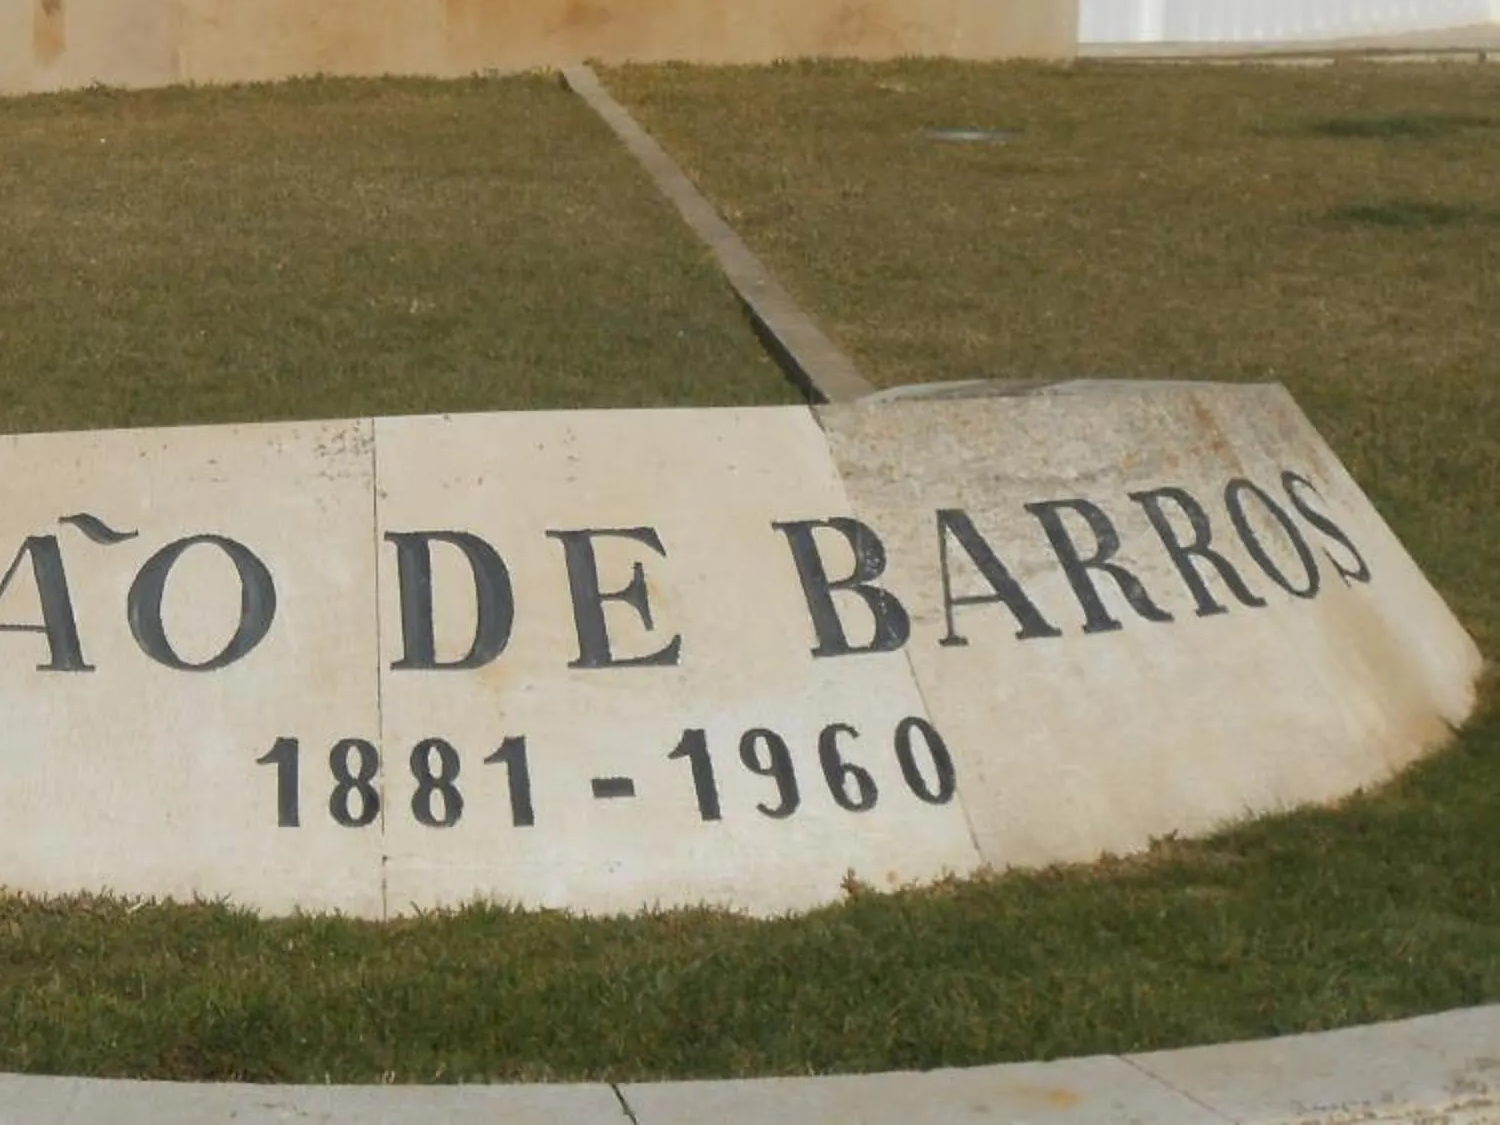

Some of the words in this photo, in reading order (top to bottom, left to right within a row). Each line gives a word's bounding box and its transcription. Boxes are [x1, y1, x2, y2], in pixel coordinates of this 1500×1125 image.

[383, 526, 683, 671] DE
[771, 470, 1371, 659] BARROS
[256, 735, 536, 828] 1881
[668, 715, 958, 823] 1960
